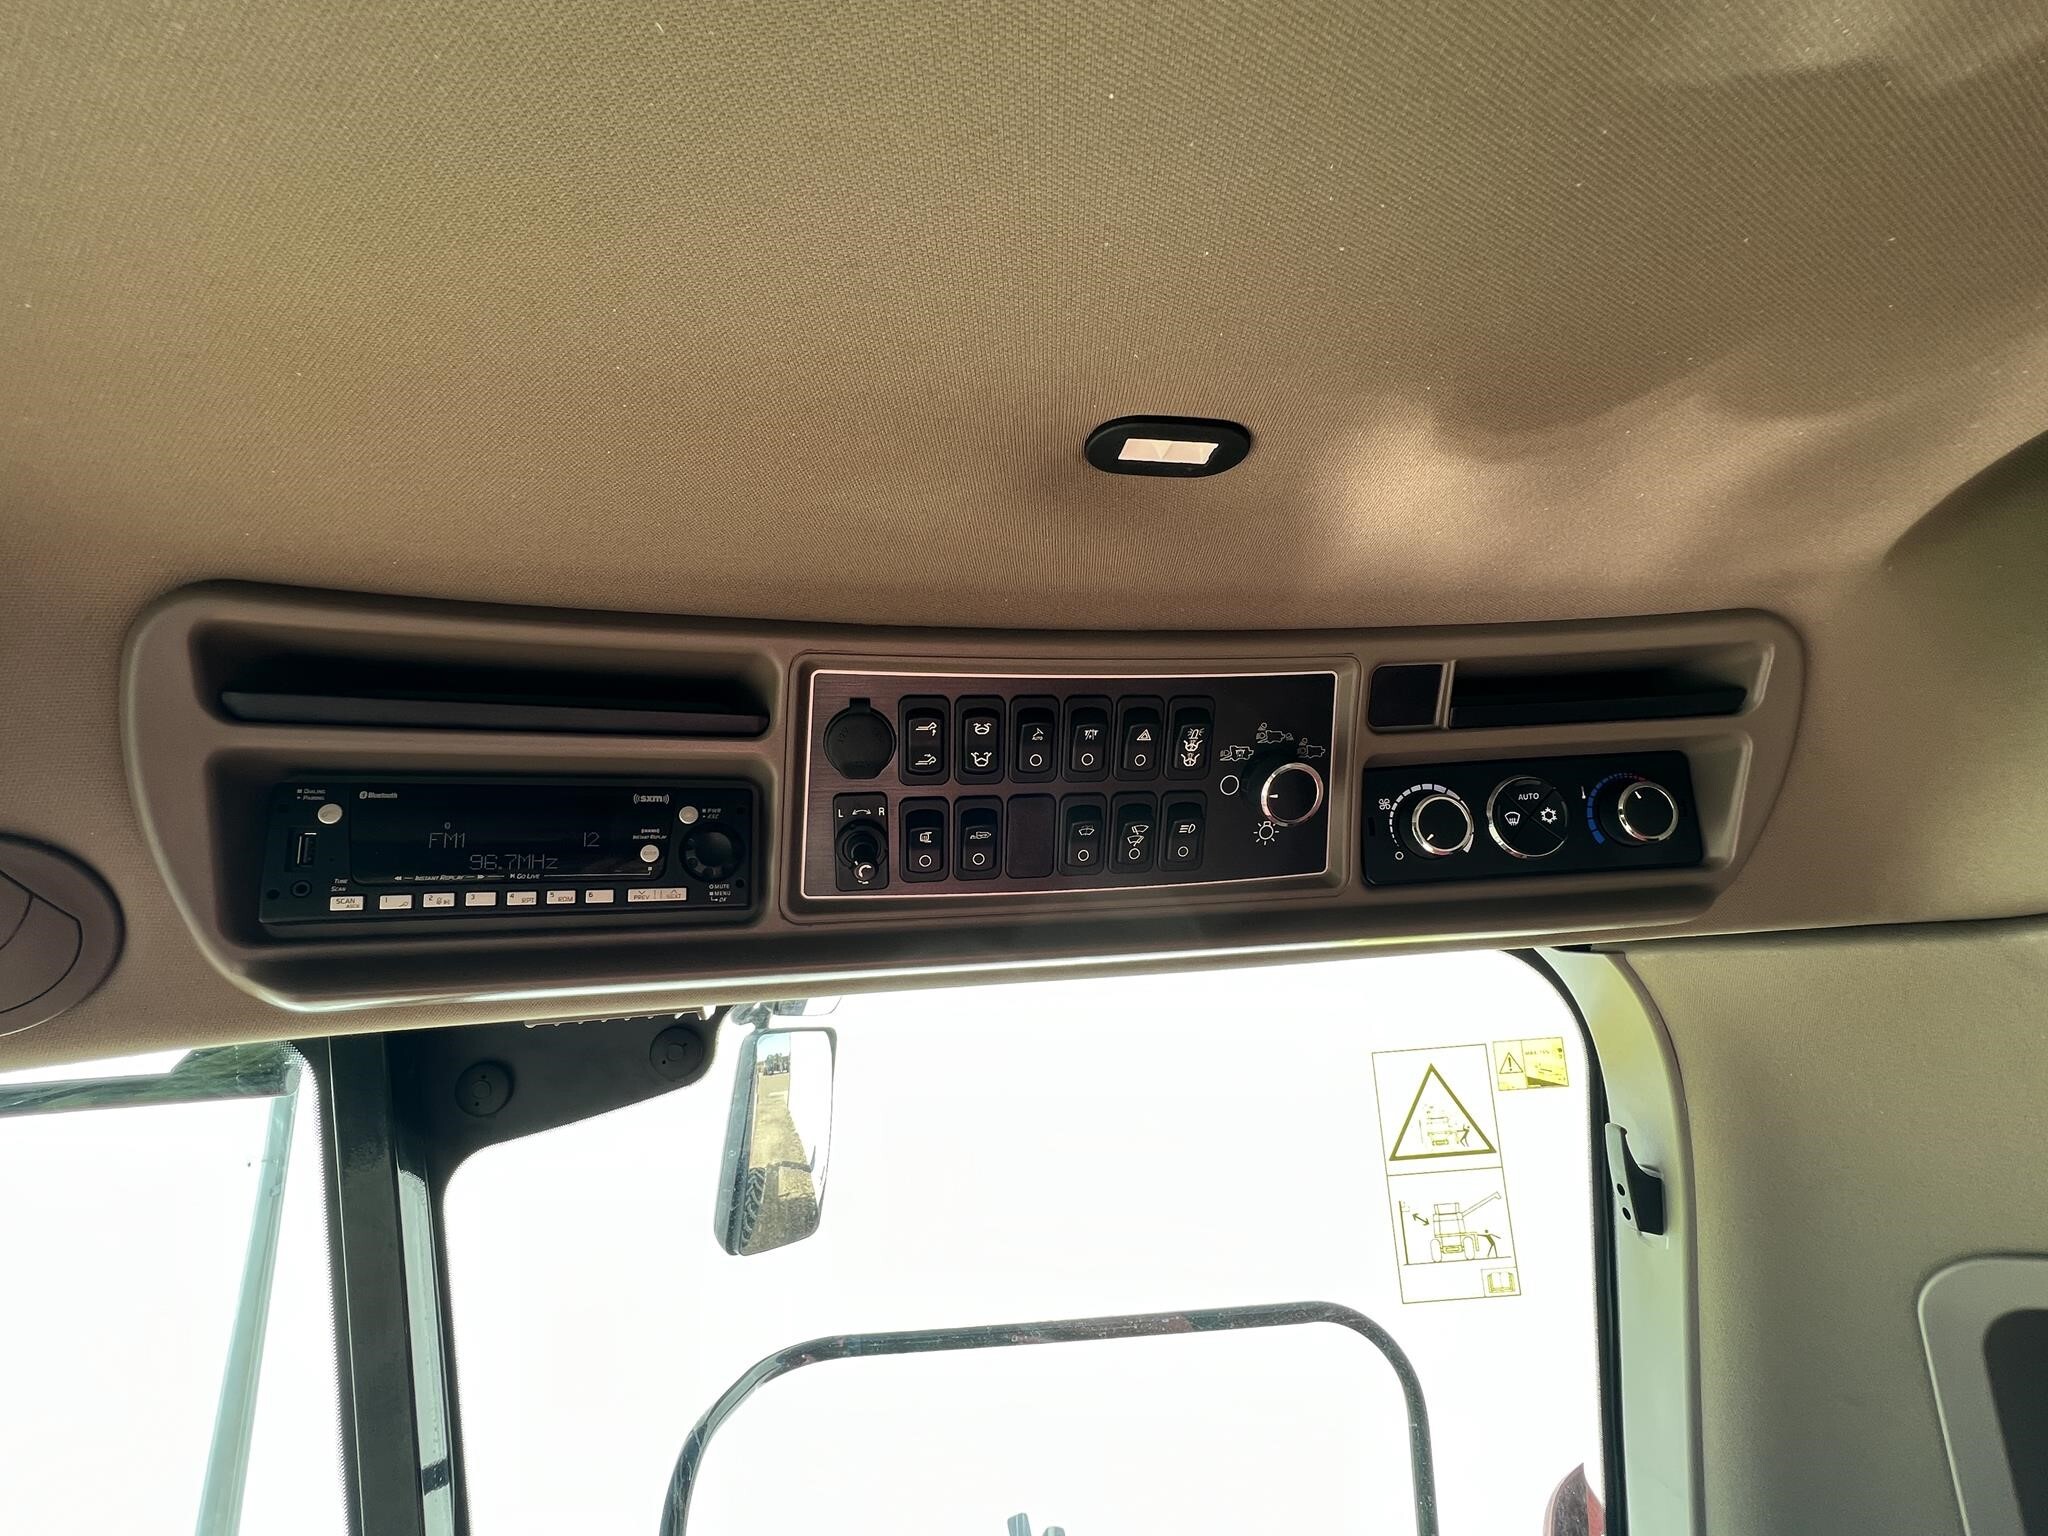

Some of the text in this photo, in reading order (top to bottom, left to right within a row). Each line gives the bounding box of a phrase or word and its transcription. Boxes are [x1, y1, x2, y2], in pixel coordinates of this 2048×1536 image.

[367, 791, 398, 799] Bluetooth
[1518, 792, 1540, 801] AUTO
[838, 808, 844, 818] L
[878, 807, 885, 816] R
[428, 832, 466, 849] FM1
[583, 831, 600, 848] 12
[469, 853, 559, 871] 96.7MHz
